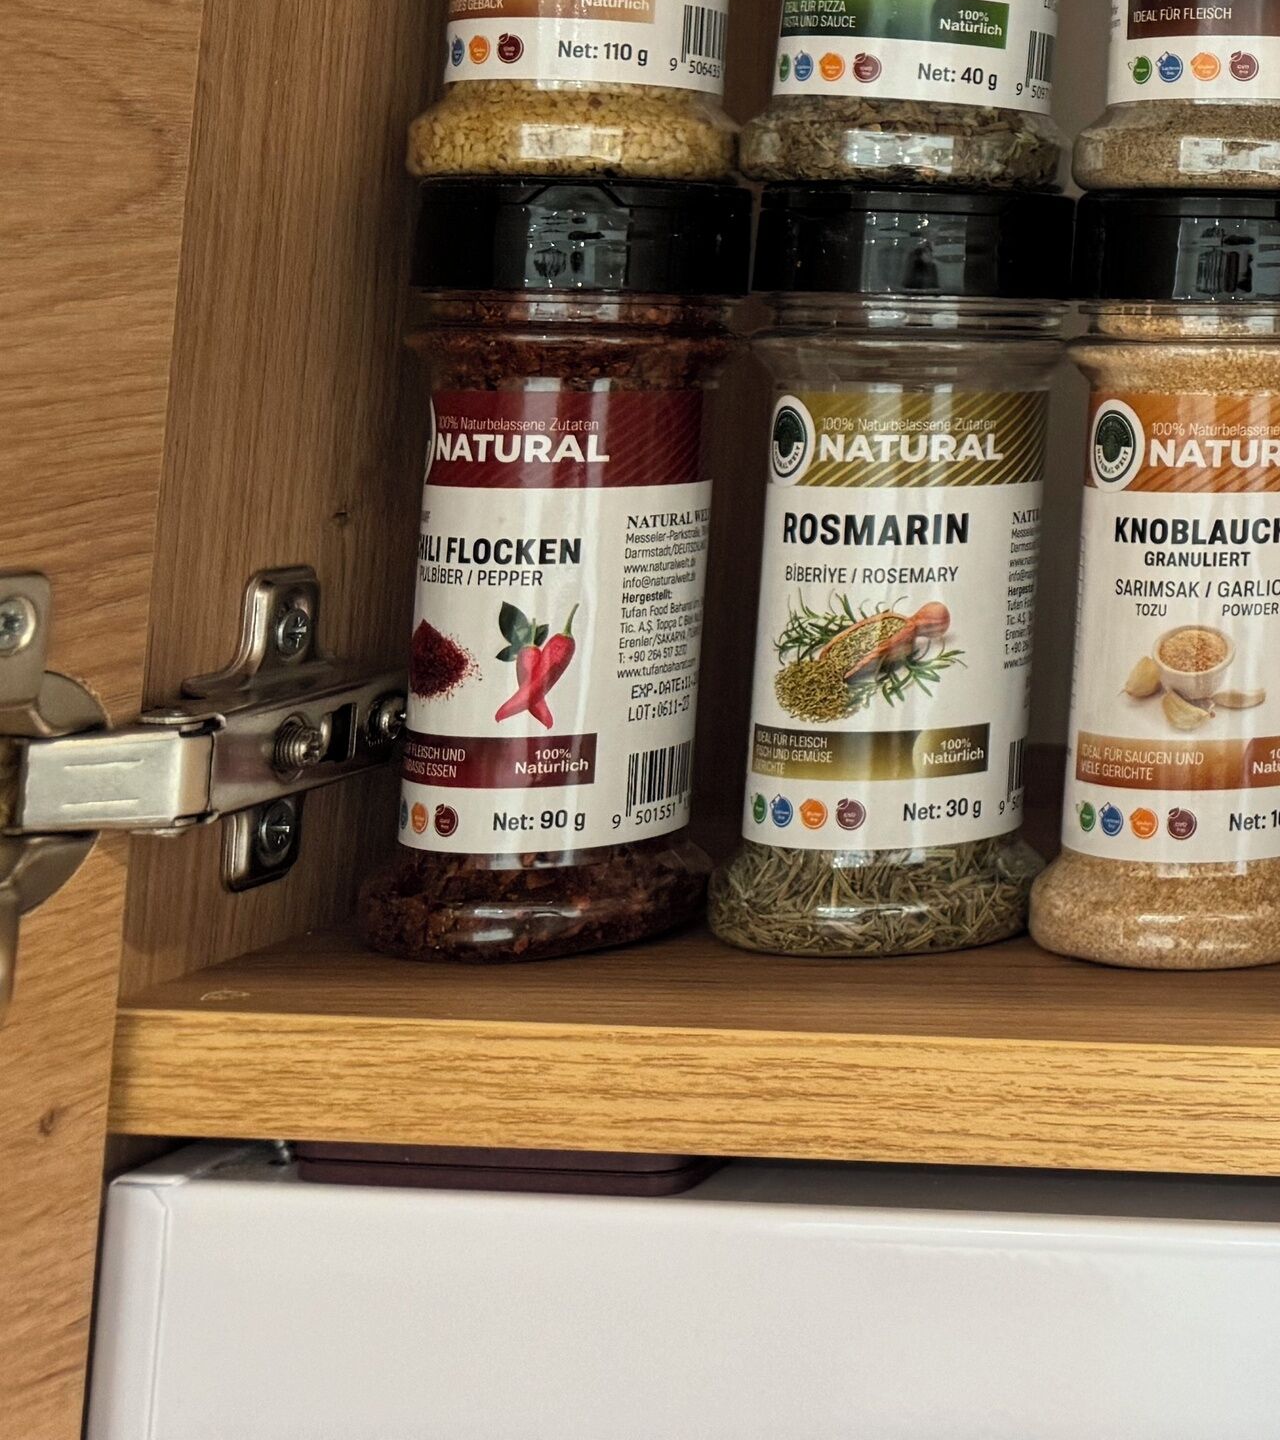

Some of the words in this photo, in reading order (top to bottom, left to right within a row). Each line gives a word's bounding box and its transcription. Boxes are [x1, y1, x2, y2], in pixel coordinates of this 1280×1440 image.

[818, 1, 846, 12] PIZZA
[800, 16, 818, 27] UND
[820, 16, 856, 28] SAUCE
[958, 9, 989, 22] 100%
[1134, 10, 1157, 23] IDEAL
[1160, 7, 1180, 20] FÜR
[1184, 7, 1232, 20] FLEISCH
[939, 19, 1002, 37] Natürlich
[558, 41, 598, 59] Net:
[604, 43, 632, 61] 110
[638, 48, 648, 66] g
[918, 63, 956, 83] Net:
[961, 67, 984, 84] 40
[988, 72, 998, 91] g
[460, 417, 546, 432] Naturbelassene
[549, 418, 599, 431] Zutaten
[822, 417, 854, 431] 100%
[858, 418, 951, 432] Naturbelassene
[954, 417, 997, 431] Zutaten
[1152, 422, 1185, 436] 100%
[1189, 422, 1280, 437] Naturbelassene
[436, 433, 610, 462] NATURAL
[819, 433, 1004, 462] NATURAL
[627, 511, 693, 529] NATURAL
[783, 512, 970, 545] ROSMARIN
[446, 537, 582, 565] FLOCKEN
[1144, 551, 1251, 568] GRANULIERT
[478, 570, 543, 586] PEPPER
[786, 563, 847, 583] BİBERİYE
[862, 566, 959, 584] ROSEMARY
[1115, 579, 1199, 598] SARIMSAK
[622, 607, 647, 618] Tufan
[1136, 603, 1167, 617] TOZU
[1222, 602, 1279, 617] POWDER
[629, 651, 645, 662] +90
[790, 736, 827, 748] FLEISCH
[940, 738, 971, 750] 100%
[442, 749, 465, 762] UND
[535, 748, 571, 759] 100%
[773, 748, 789, 760] UND
[791, 749, 833, 763] GEMÜSE
[923, 748, 984, 766] Natürlich
[1104, 746, 1122, 761] FÜR
[1124, 750, 1172, 765] SAUCEN
[1176, 751, 1204, 765] UND
[426, 765, 457, 778] ESSEN
[515, 758, 589, 775] Natürlich
[1102, 764, 1154, 780] GERICHTE
[903, 801, 942, 821] Net:
[946, 798, 968, 817] 30
[972, 798, 982, 818] g
[493, 811, 534, 832] Net:
[540, 809, 568, 830] 90
[574, 811, 586, 831] g
[1229, 812, 1266, 832] Net:
